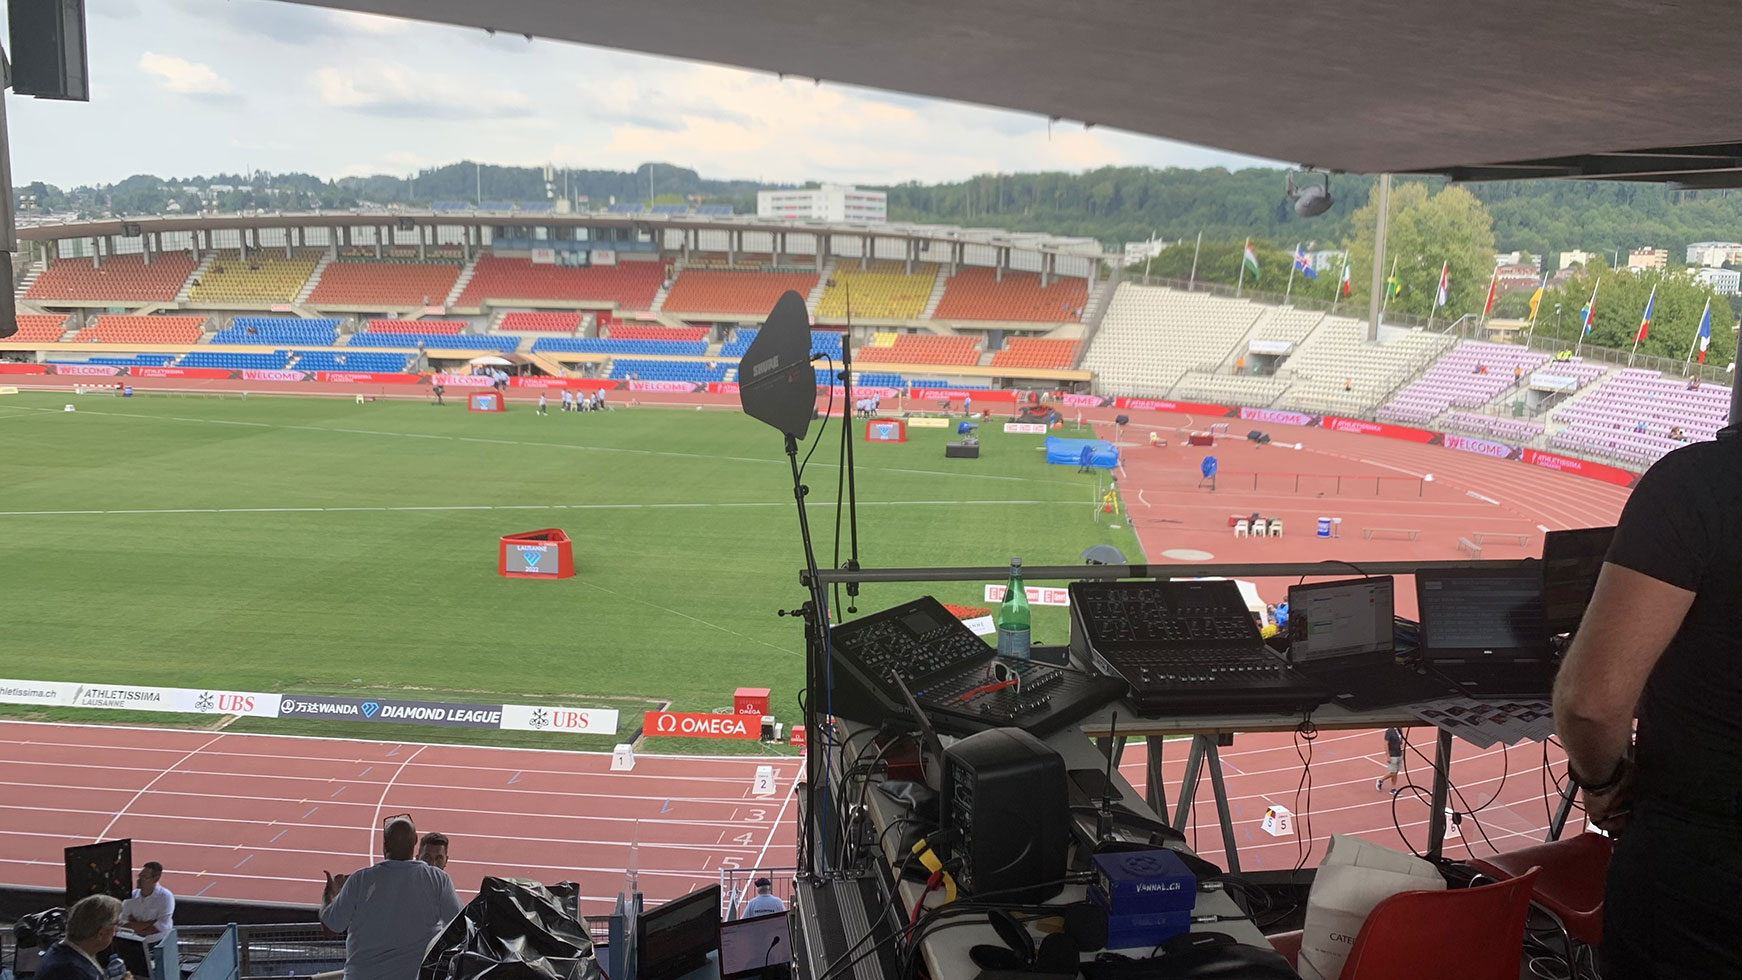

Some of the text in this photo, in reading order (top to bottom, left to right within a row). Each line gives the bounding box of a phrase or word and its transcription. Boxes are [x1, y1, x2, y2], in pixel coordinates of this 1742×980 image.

[60, 366, 112, 376] WELCOME
[244, 370, 297, 380] WELCOME
[632, 381, 688, 391] WELCOME
[1246, 410, 1302, 423] WELCOME
[1449, 436, 1502, 457] WELCOME
[84, 689, 161, 702] ATHLETISSIMA
[82, 699, 125, 707] LAUSANNE
[218, 694, 255, 712] UBS
[381, 705, 445, 720] DIAMOND
[447, 709, 501, 724] LEAGUE
[553, 711, 589, 729] UBS
[681, 718, 747, 735] OMEGA
[619, 757, 623, 766] 1
[761, 780, 767, 789] 2
[744, 809, 766, 821] 3
[1280, 819, 1287, 830] 5
[733, 832, 753, 846] 4
[718, 857, 744, 870] 5
